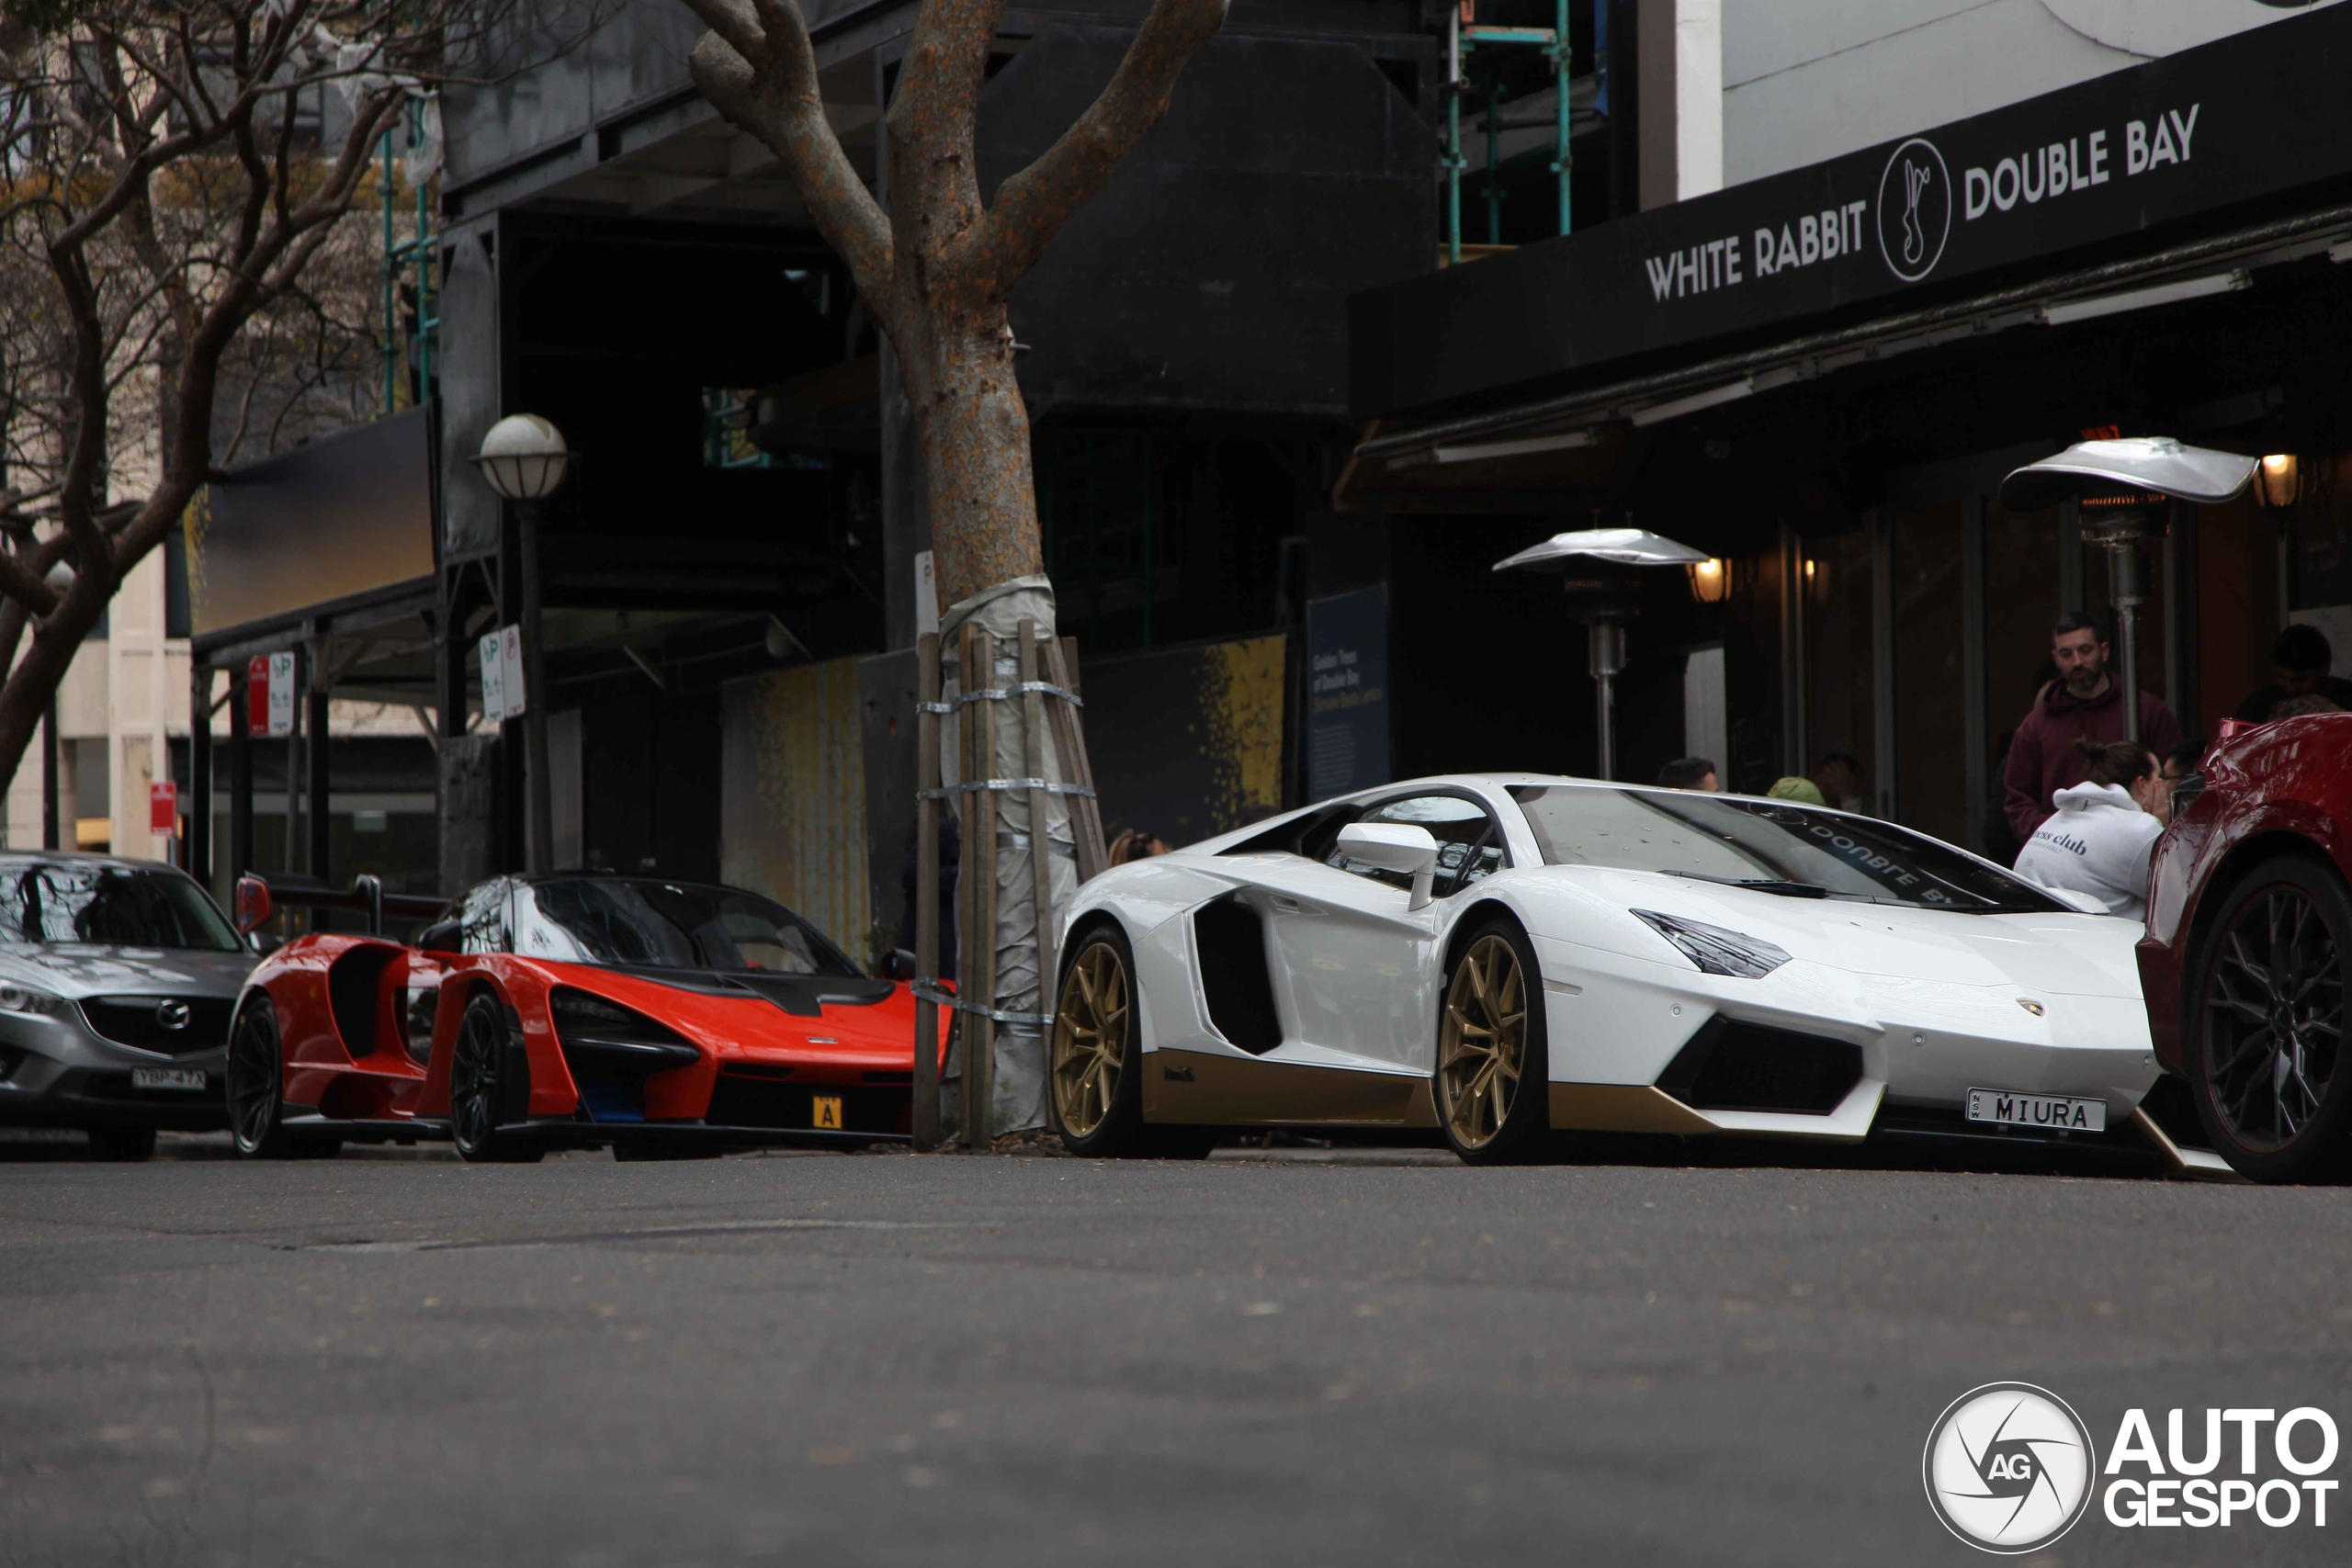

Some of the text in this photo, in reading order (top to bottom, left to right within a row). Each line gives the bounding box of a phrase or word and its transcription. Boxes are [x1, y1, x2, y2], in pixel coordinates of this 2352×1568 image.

[1645, 103, 2199, 302] WHITE RABBIT DOUBLE BAY
[2052, 833, 2086, 855] club
[821, 1103, 834, 1125] A
[1971, 1093, 1981, 1119] NSW
[1996, 1098, 2087, 1128] MIURA
